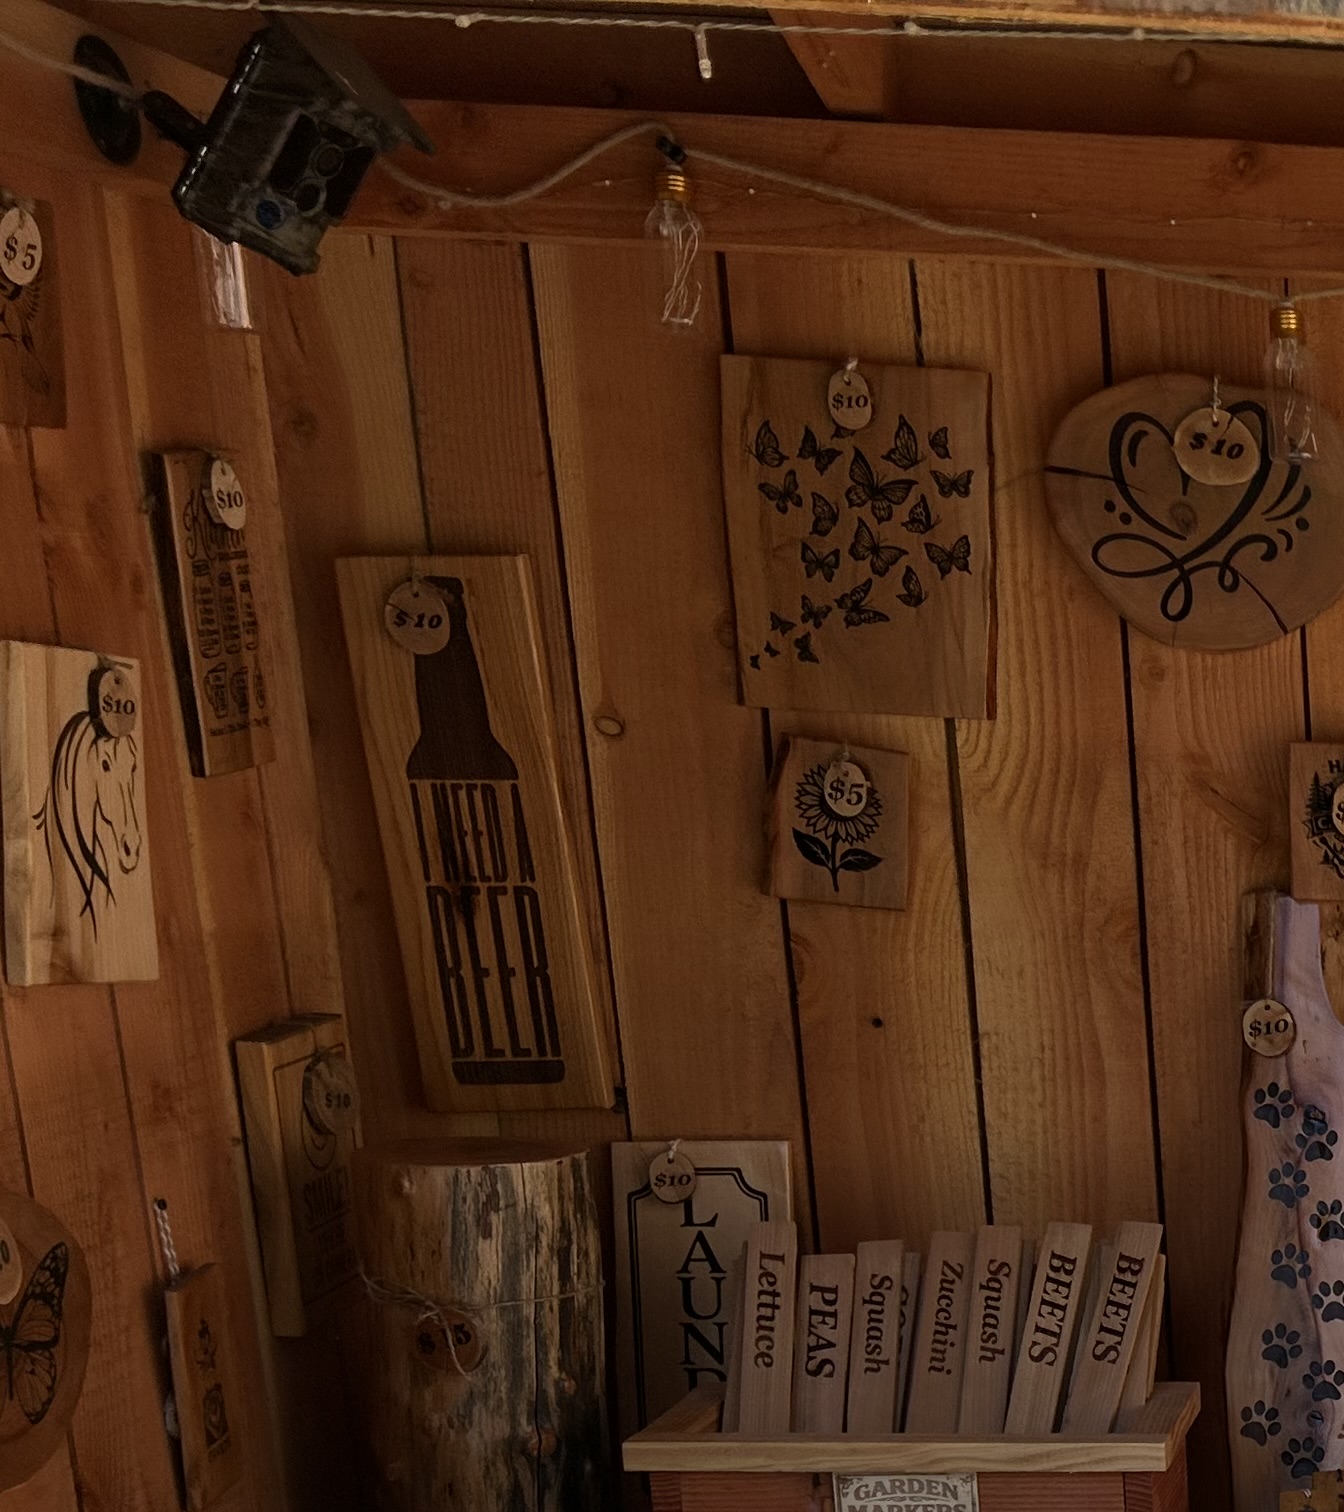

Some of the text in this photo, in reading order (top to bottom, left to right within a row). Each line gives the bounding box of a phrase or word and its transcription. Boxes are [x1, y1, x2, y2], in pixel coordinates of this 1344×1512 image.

[4, 235, 37, 271] $5
[831, 393, 868, 411] $10
[1189, 432, 1244, 460] $10
[216, 490, 244, 511] $10
[393, 611, 443, 631] $10
[101, 694, 136, 716] $10
[827, 777, 867, 808] $5
[430, 782, 508, 883] NEED
[425, 885, 562, 1059] BEER
[1249, 1018, 1289, 1041] $10
[653, 1173, 692, 1191] $10
[753, 1250, 786, 1369] Lettuce
[862, 1273, 894, 1375] Squash
[927, 1259, 964, 1376] Zucchini
[978, 1257, 1012, 1364] Squash
[1027, 1250, 1078, 1368] BEETS
[1092, 1251, 1146, 1365] BEETS
[804, 1281, 840, 1379] PEAS
[853, 1477, 960, 1502] GARDEN
